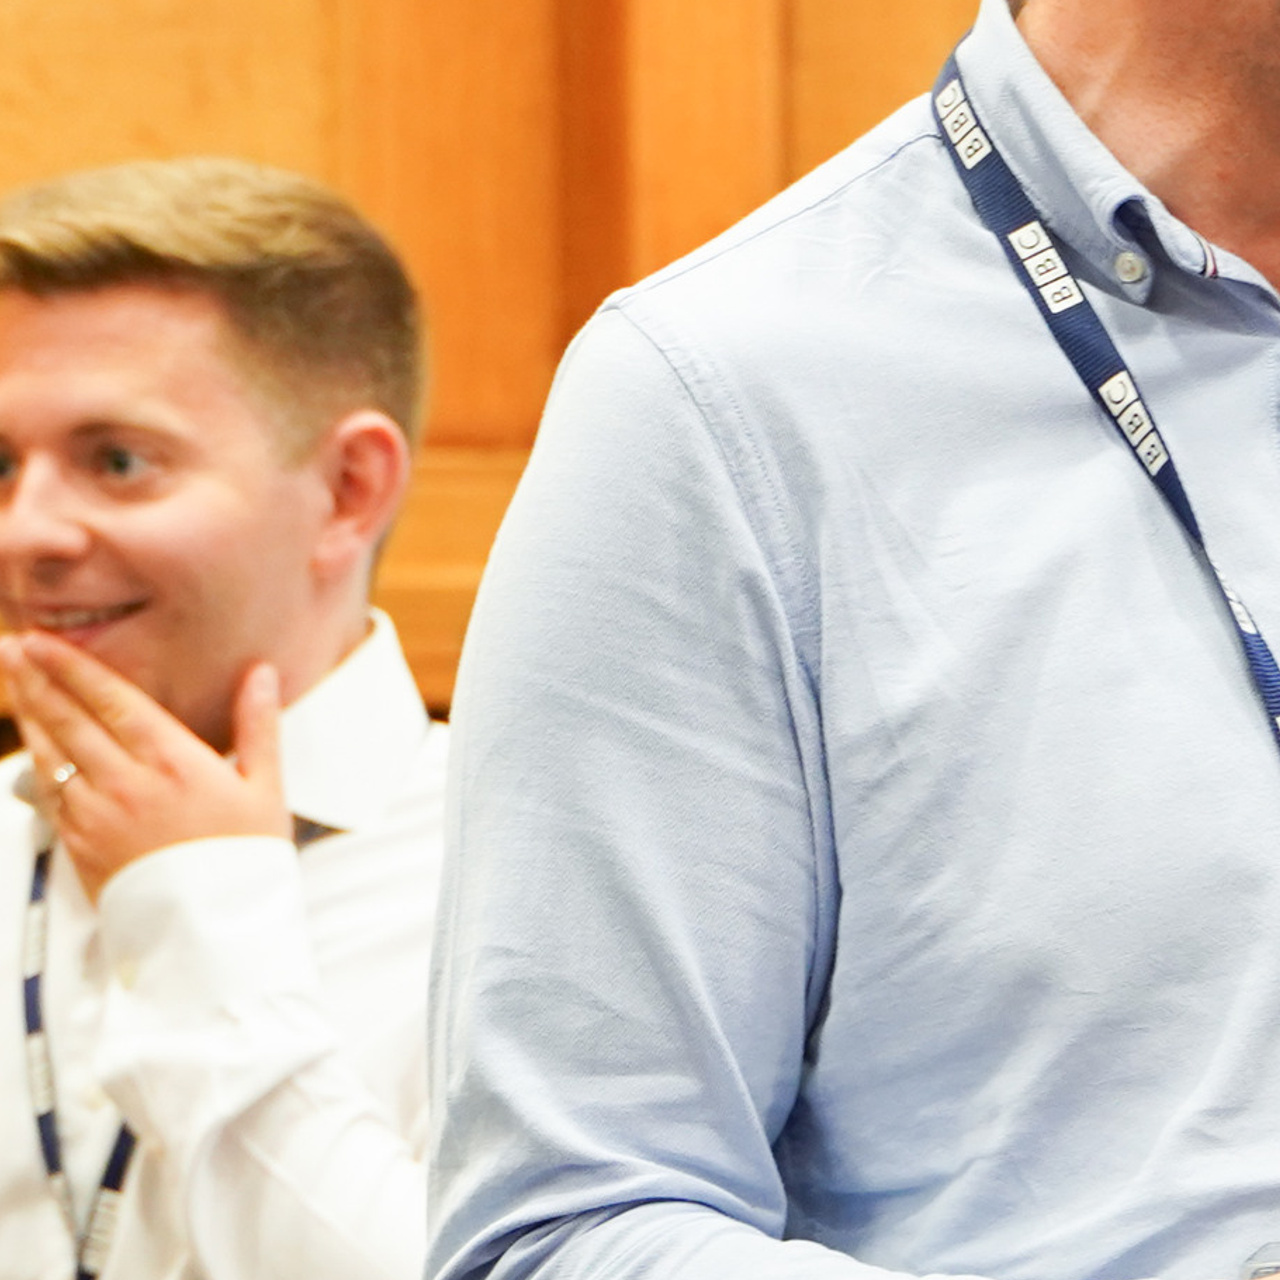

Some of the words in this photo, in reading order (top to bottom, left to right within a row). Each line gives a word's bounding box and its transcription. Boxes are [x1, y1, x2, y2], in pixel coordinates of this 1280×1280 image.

[937, 80, 991, 168] BBC
[1009, 222, 1083, 313] BBC
[1099, 372, 1168, 475] BBC
